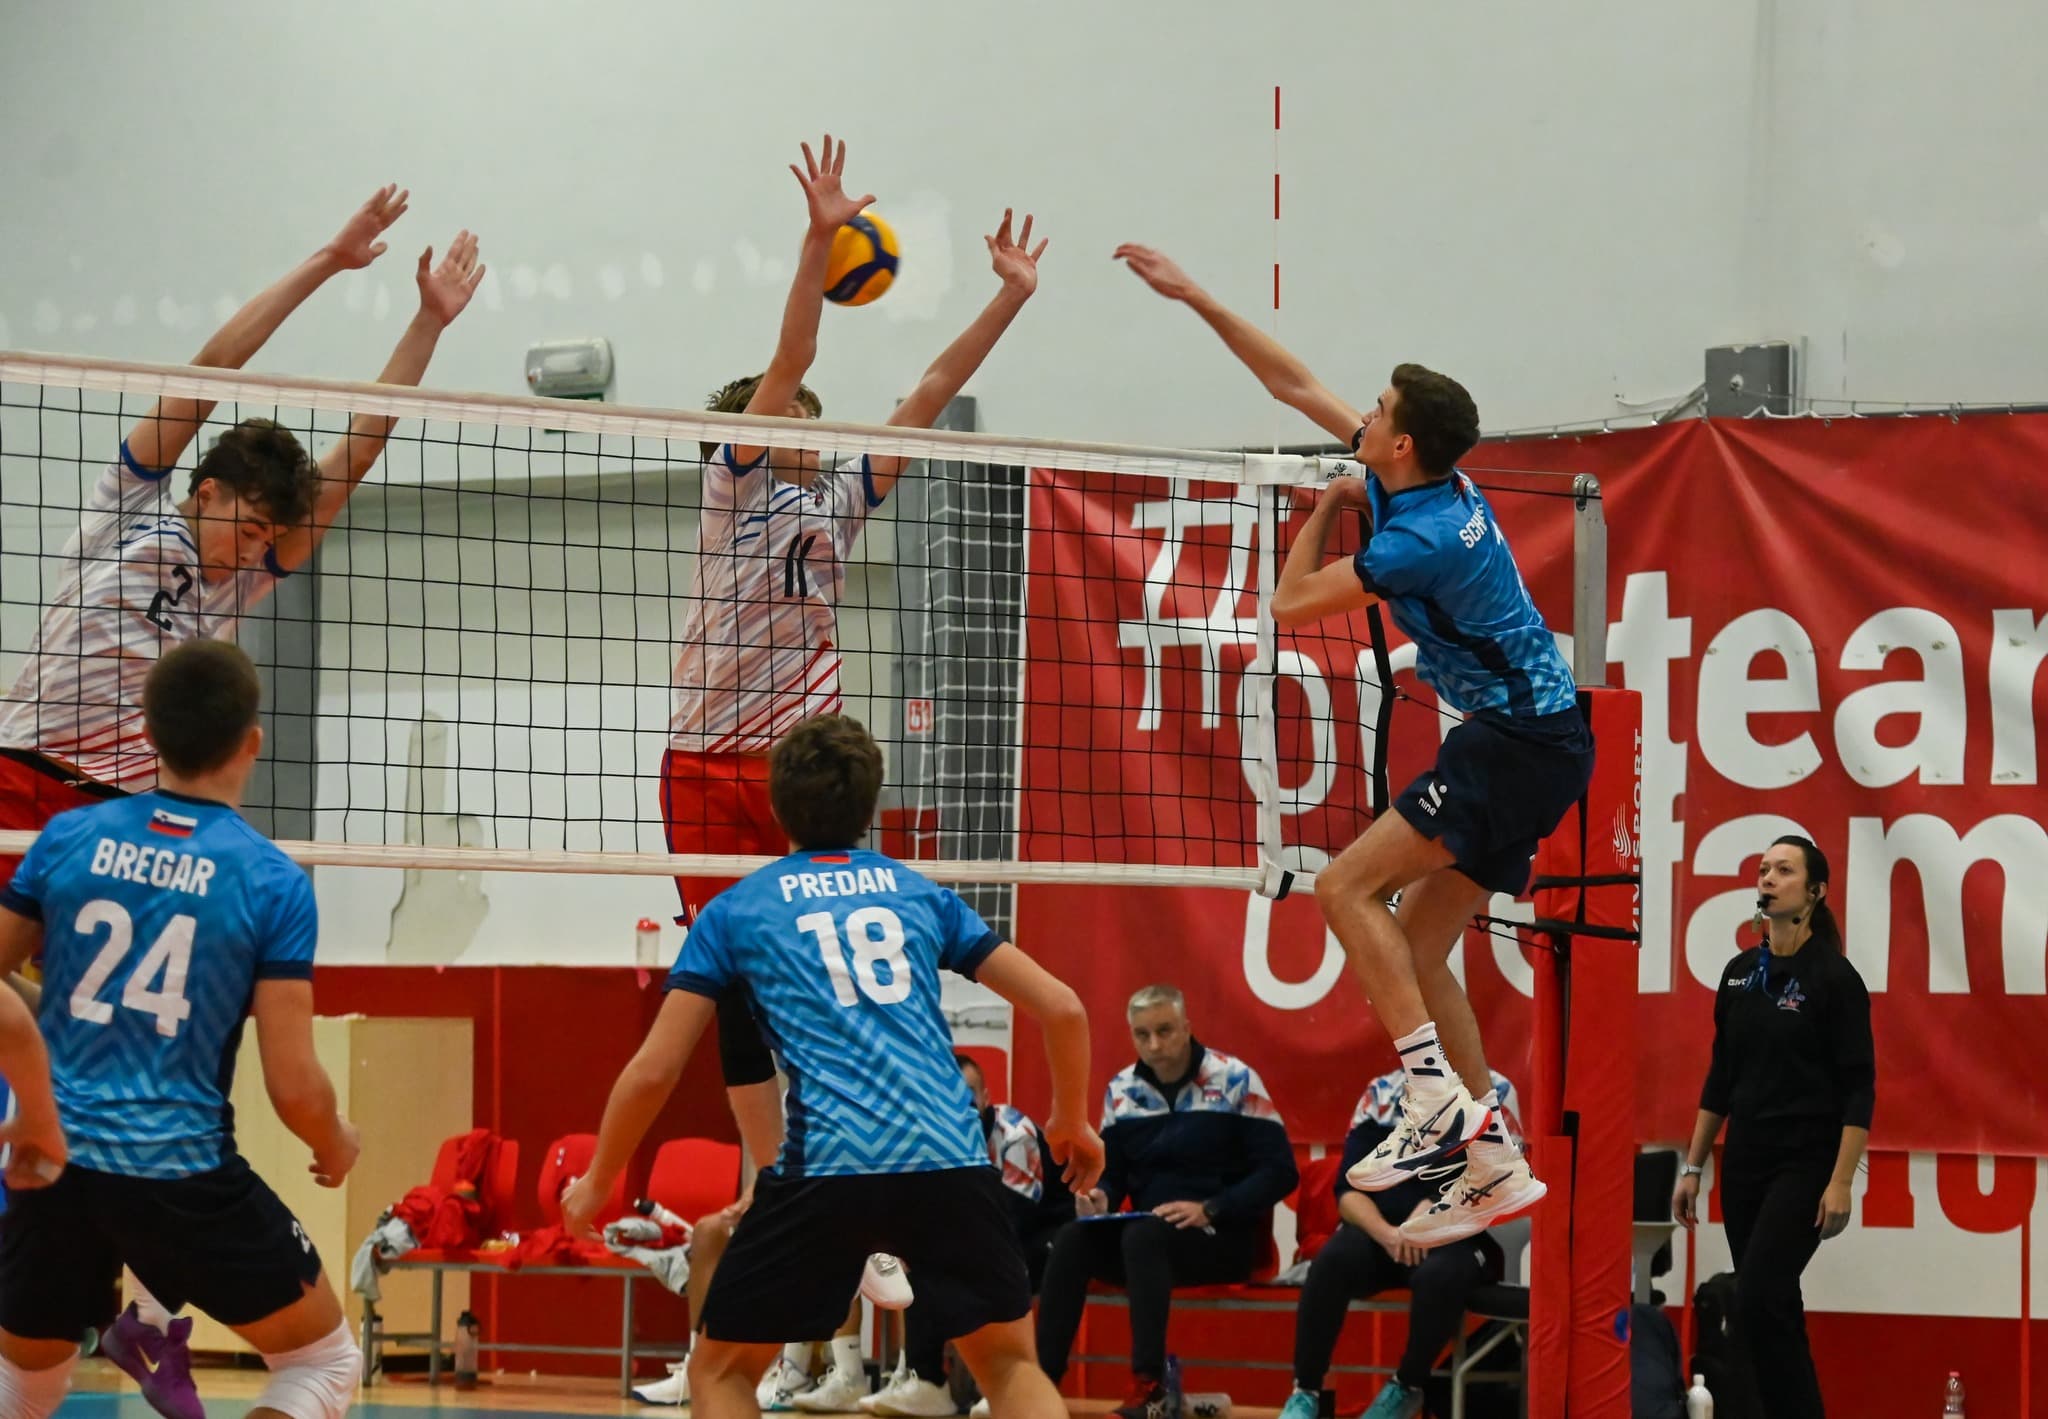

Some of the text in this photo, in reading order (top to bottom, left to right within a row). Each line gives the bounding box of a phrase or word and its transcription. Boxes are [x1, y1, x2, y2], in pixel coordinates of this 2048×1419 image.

[784, 532, 816, 597] 11
[1418, 797, 1437, 817] nine
[90, 837, 216, 897] BREGAR
[779, 867, 898, 903] PREDAN
[69, 899, 197, 1038] 24
[796, 906, 912, 1008] 18
